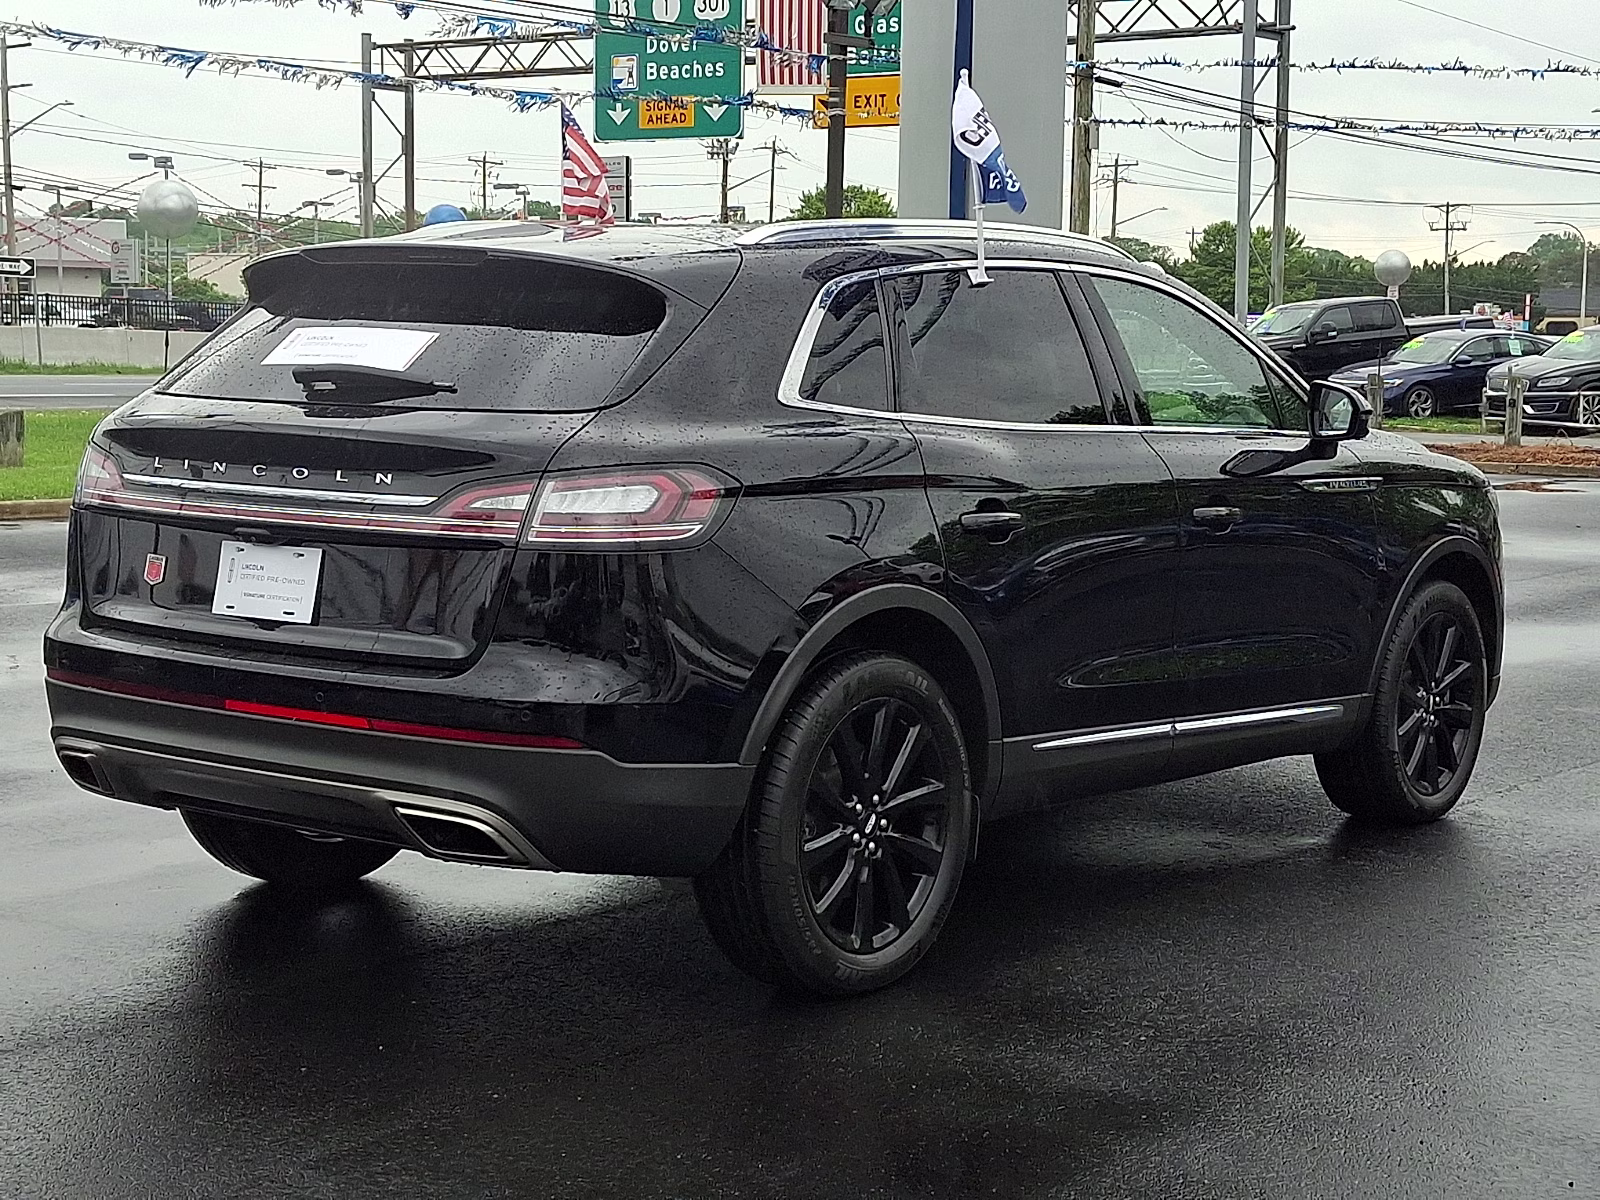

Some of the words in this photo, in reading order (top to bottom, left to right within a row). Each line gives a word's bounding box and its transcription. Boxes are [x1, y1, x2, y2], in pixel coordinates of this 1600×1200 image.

[646, 60, 725, 81] Beaches
[853, 94, 887, 109] EXIT
[646, 112, 688, 125] AHEAD
[153, 456, 394, 485] LINCOLN
[241, 563, 265, 571] LINCOLN
[266, 575, 306, 586] PRE-OWNED
